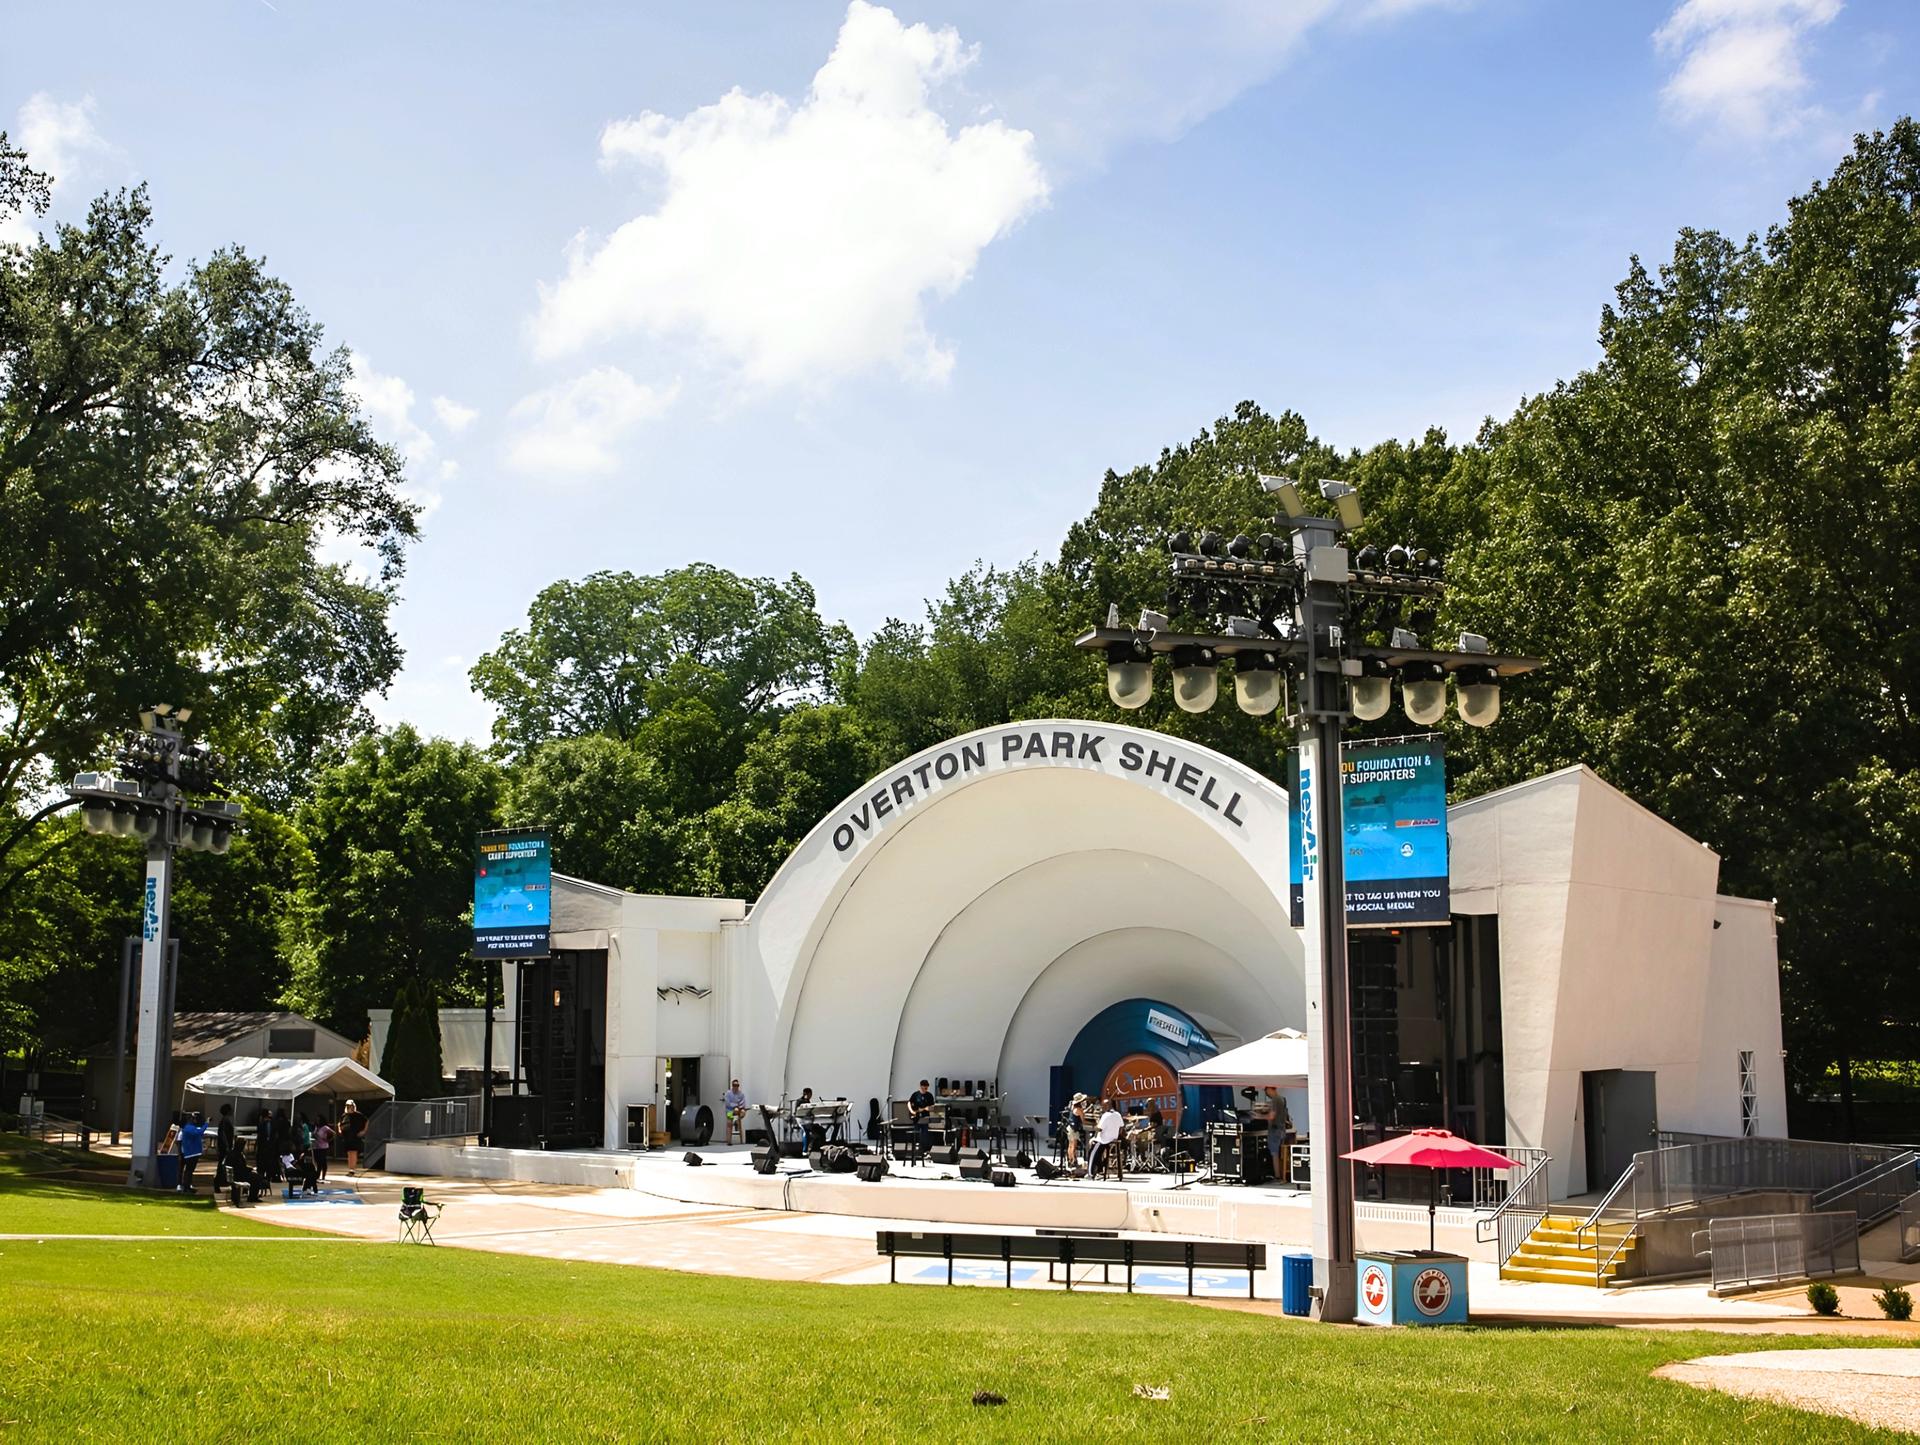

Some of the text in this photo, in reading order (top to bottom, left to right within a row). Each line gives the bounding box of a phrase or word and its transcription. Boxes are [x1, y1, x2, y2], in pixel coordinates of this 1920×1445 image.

[1341, 755, 1431, 773] OU FOUNDATION &
[1350, 768, 1416, 784] SUPPORTERS
[832, 732, 1244, 852] OVERTON PARK SHELL
[1300, 768, 1318, 881] nexAir
[1354, 893, 1365, 901] TO
[1422, 889, 1441, 898] YOU
[1356, 903, 1385, 911] SOCIAL
